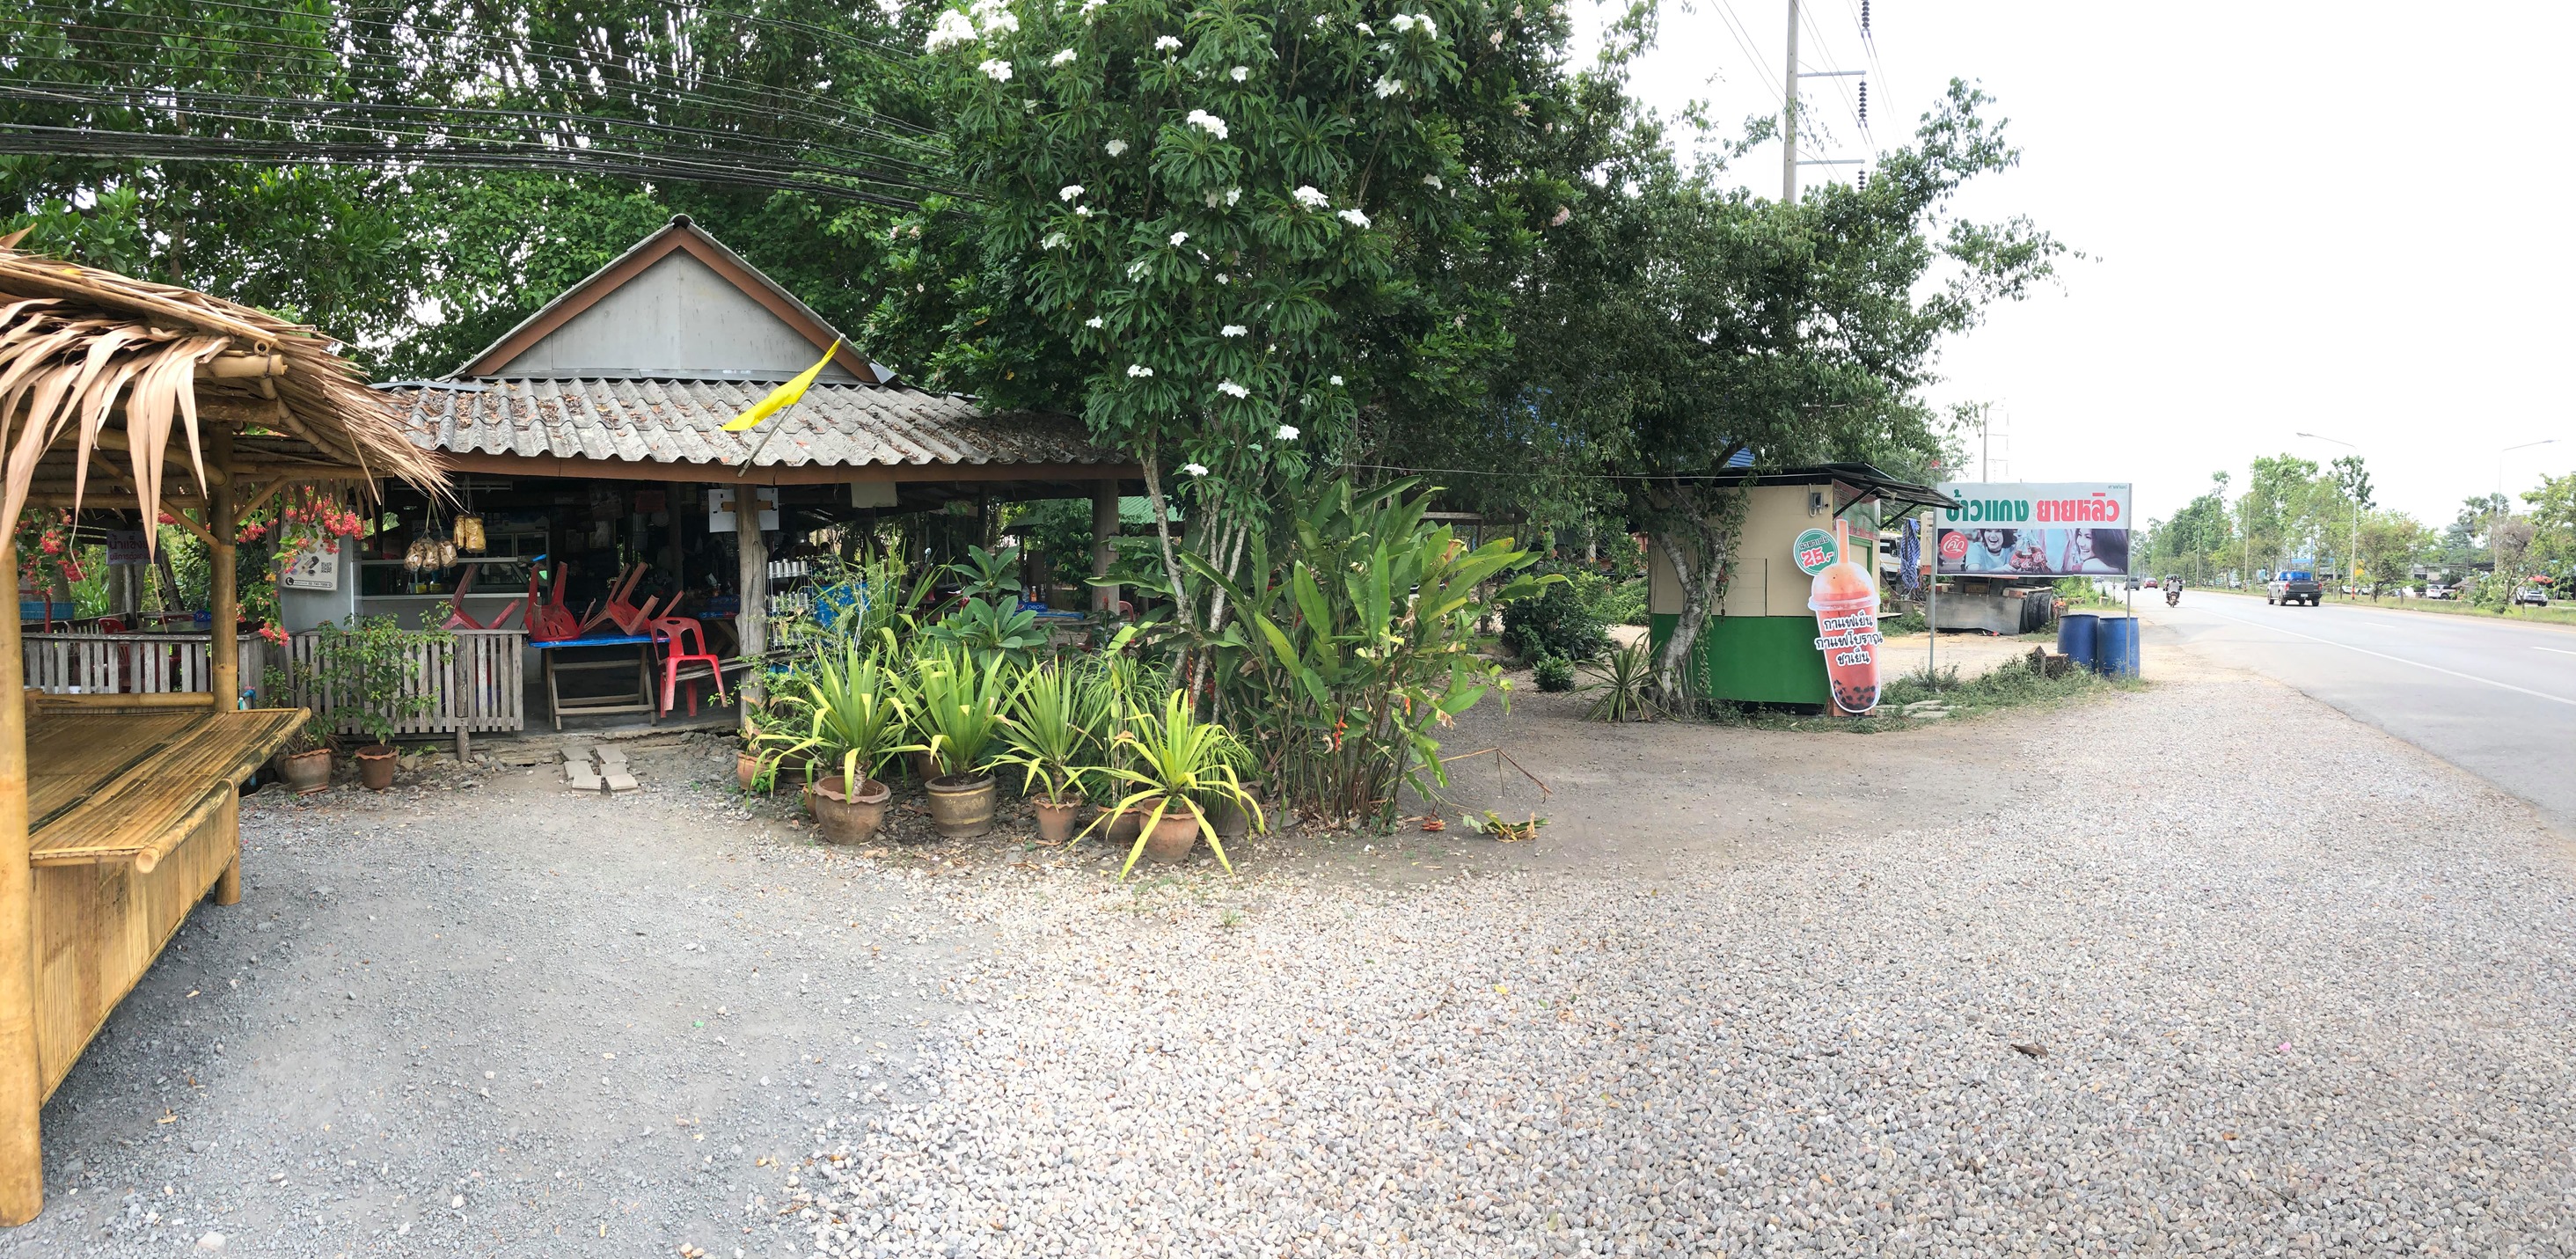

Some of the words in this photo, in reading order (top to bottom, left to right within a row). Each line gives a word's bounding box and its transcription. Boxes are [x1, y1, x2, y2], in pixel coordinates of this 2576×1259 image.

[2037, 493, 2120, 522] ยายหลิว
[1824, 611, 1873, 630] กาแฟเย็น
[1816, 631, 1883, 648] กาแฟโบราณ
[1837, 648, 1870, 665] ชาเย็น
